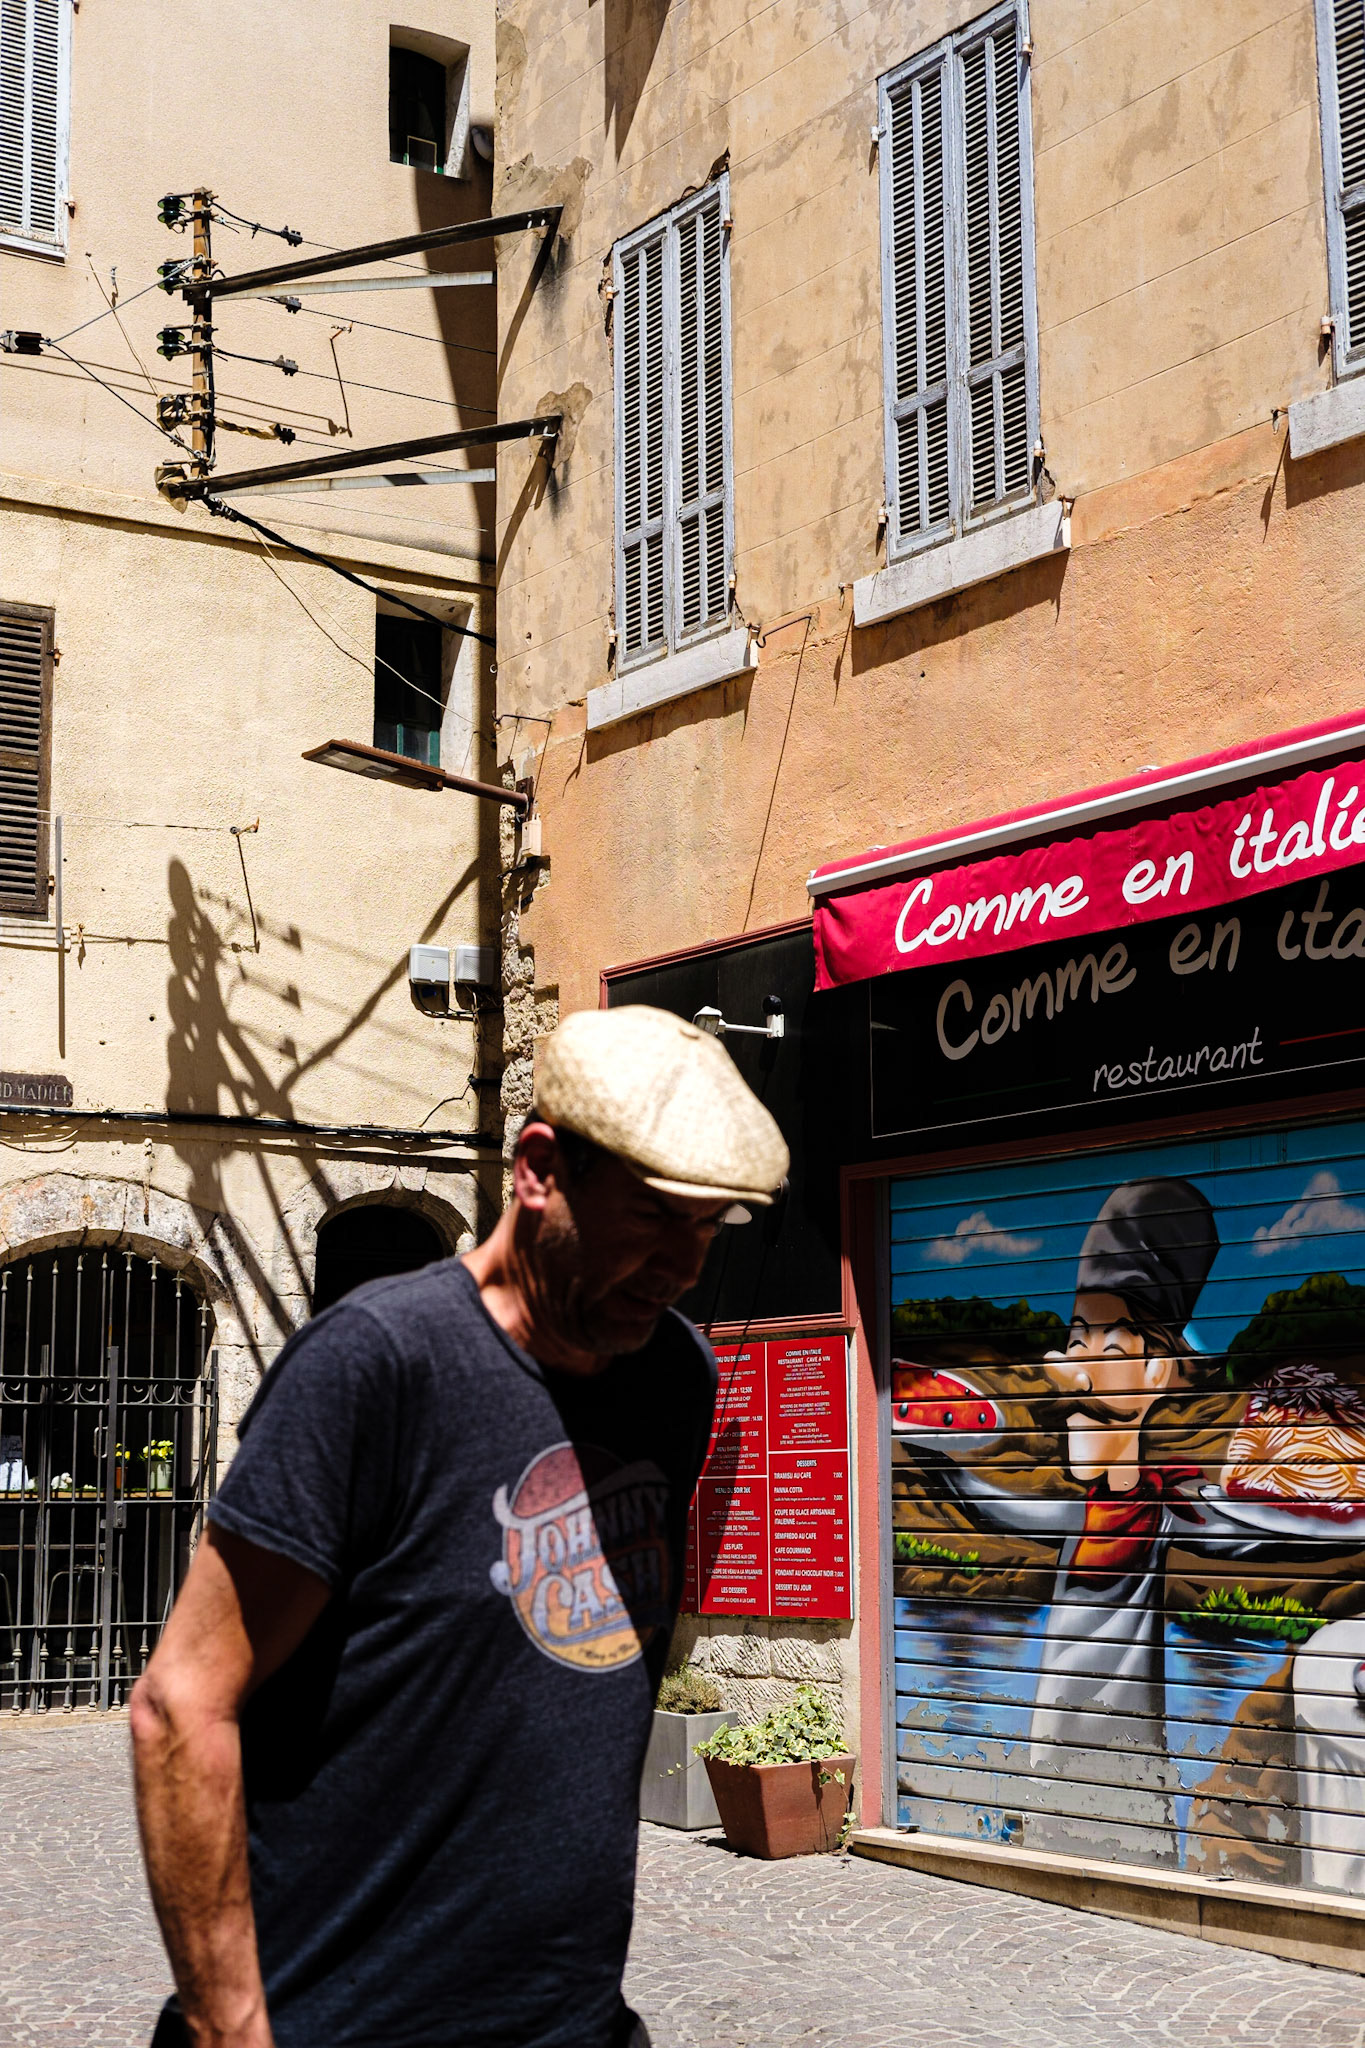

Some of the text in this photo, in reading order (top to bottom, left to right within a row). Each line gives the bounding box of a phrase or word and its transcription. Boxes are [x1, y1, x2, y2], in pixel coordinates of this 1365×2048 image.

[894, 878, 1089, 954] Comme
[1122, 850, 1195, 904] en
[936, 942, 1136, 1062] Comme
[1168, 917, 1241, 975] en
[1092, 1026, 1264, 1092] restaurant
[490, 1465, 672, 1596] JOHNNY
[532, 1549, 664, 1645] CASH
